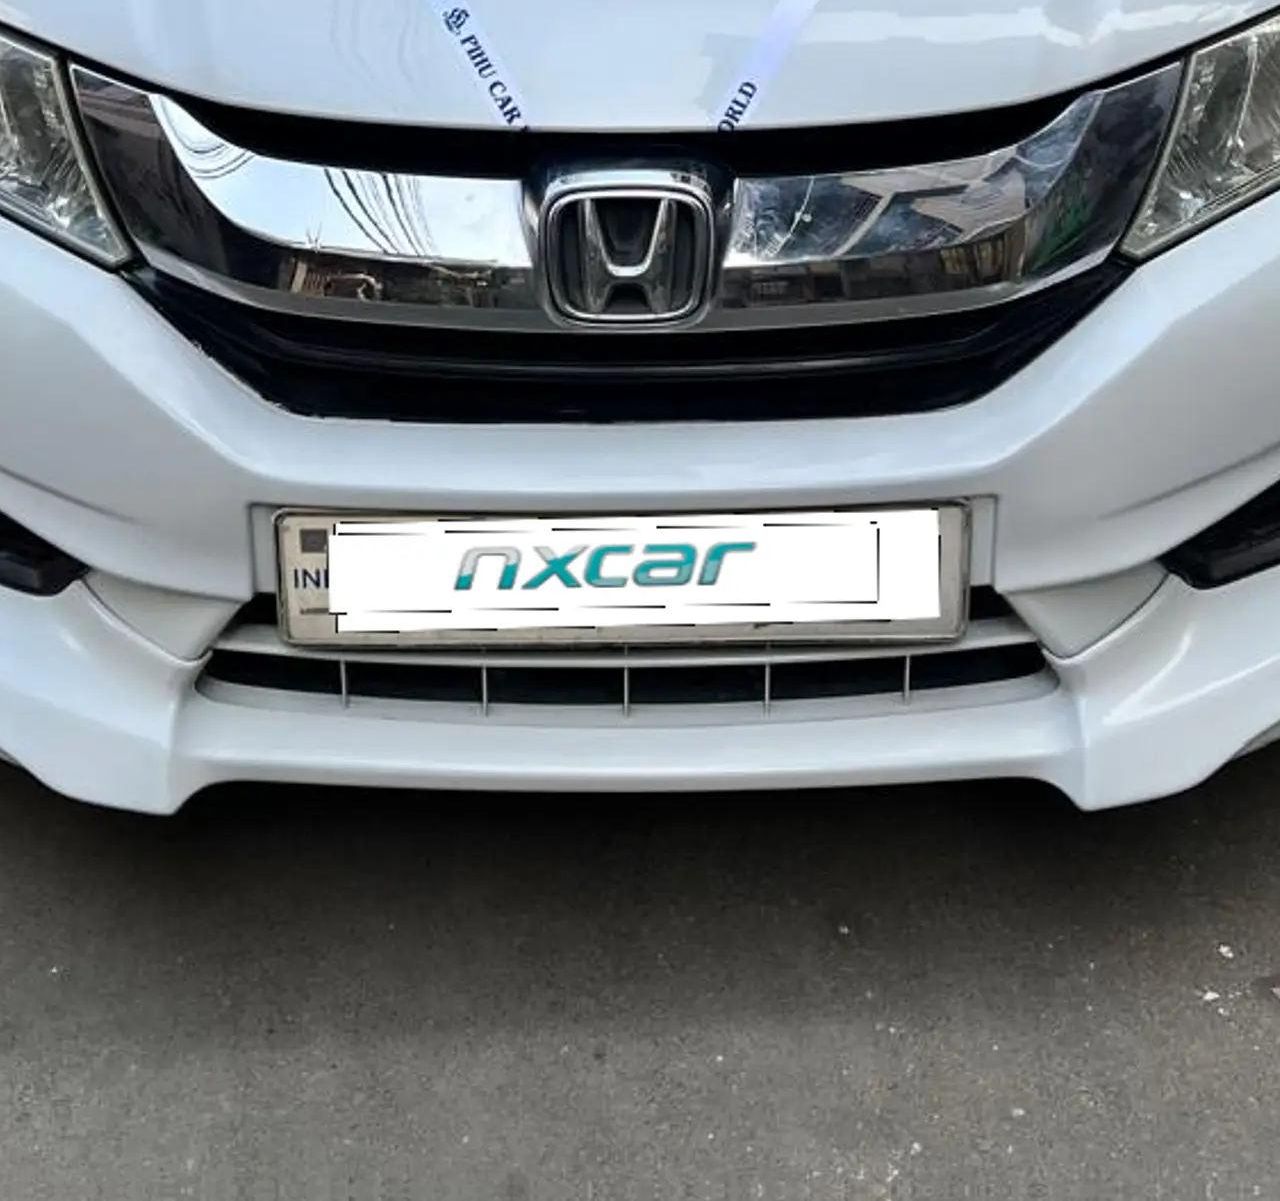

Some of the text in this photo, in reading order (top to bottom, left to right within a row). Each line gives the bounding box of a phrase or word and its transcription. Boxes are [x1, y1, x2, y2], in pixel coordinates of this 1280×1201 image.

[460, 34, 521, 125] PIHU CAR
[718, 82, 757, 132] ORLD
